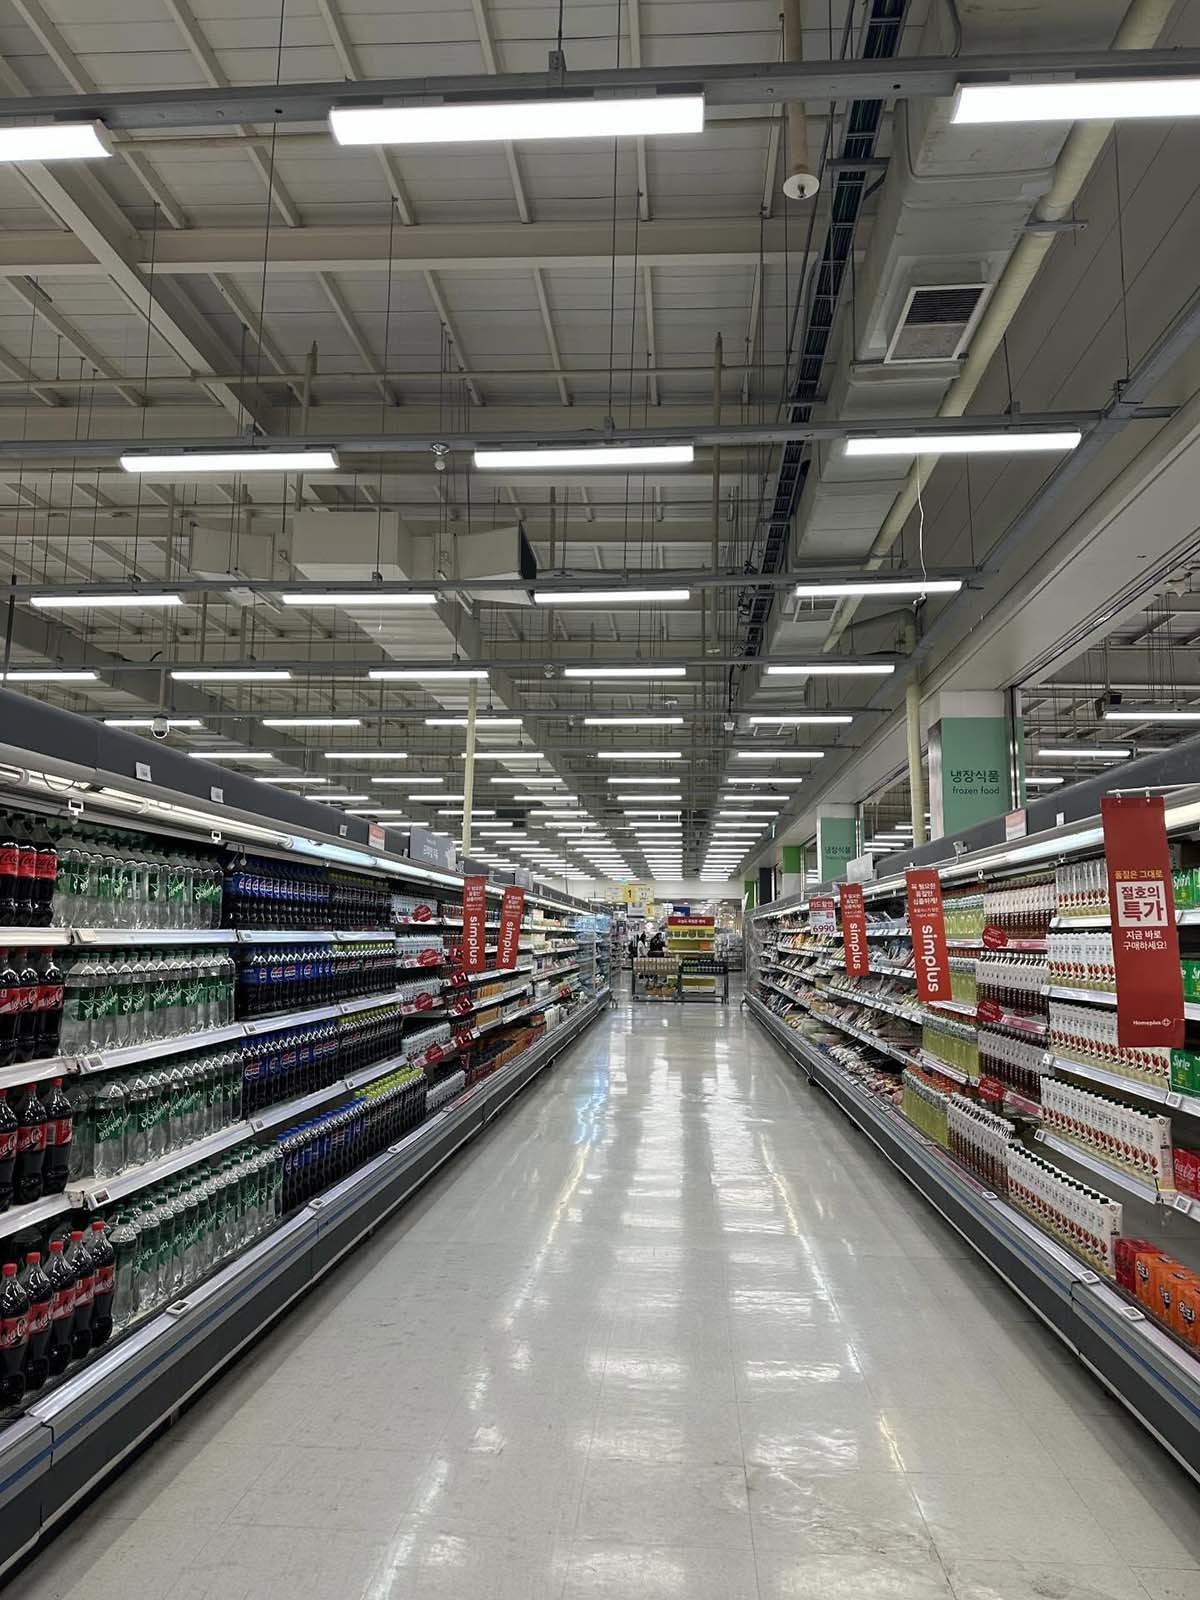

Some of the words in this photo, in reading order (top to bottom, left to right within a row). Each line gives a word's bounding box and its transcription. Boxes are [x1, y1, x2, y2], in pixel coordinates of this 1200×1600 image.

[951, 770, 999, 783] 냉장식품
[952, 786, 978, 794] frozen
[980, 786, 1000, 794] food
[1115, 870, 1137, 880] 품질은
[1139, 869, 1163, 879] 그대로
[1121, 885, 1160, 900] 절호의
[1123, 901, 1164, 921] 특가
[468, 916, 480, 965] simplus
[502, 921, 516, 963] simplus
[1126, 931, 1143, 940] 지금
[1144, 930, 1162, 939] 바로
[849, 922, 863, 969] simplus
[1123, 940, 1167, 950] 구매하세요!
[921, 924, 941, 993] simplus
